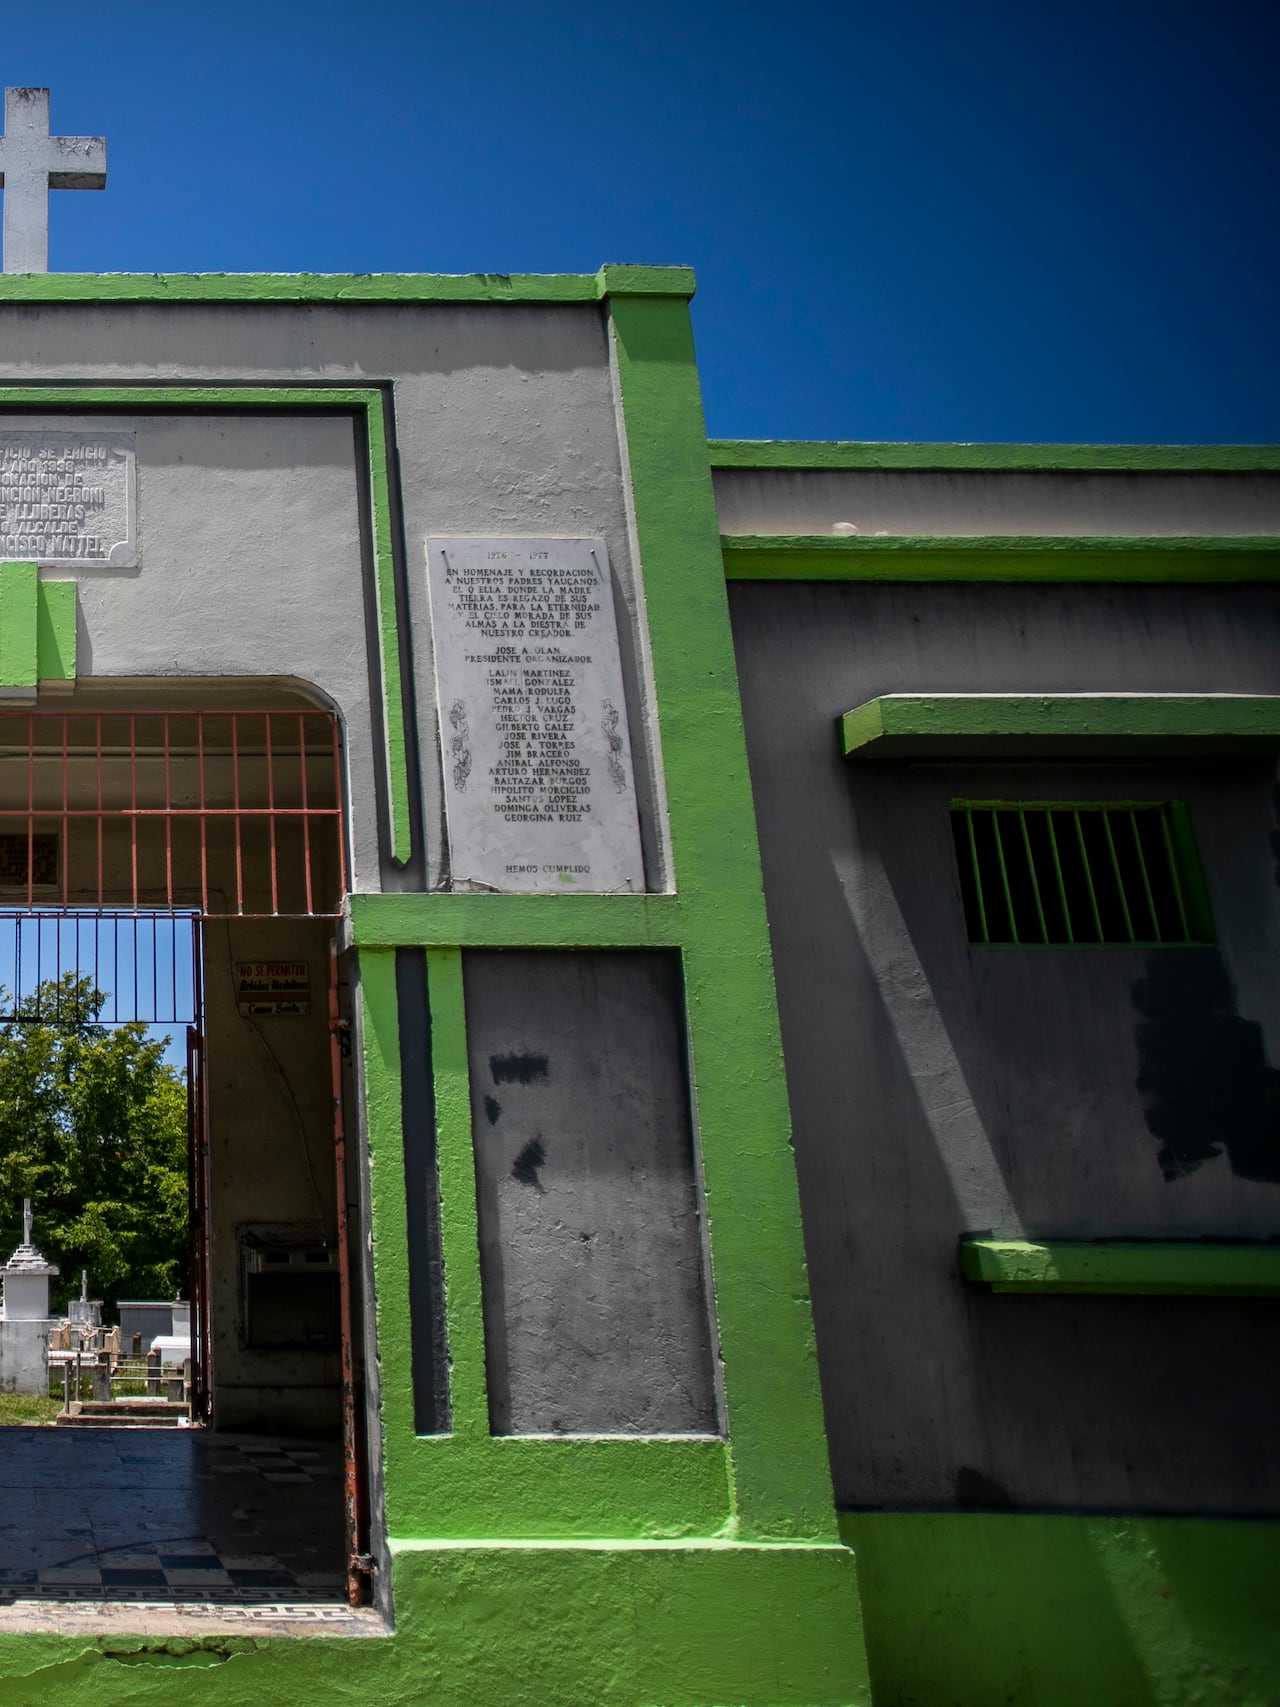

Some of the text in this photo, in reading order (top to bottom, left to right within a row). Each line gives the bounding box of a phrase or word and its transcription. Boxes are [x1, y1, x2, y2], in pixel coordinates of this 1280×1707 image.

[39, 448, 56, 458] SE
[11, 458, 37, 472] AÑO
[66, 474, 82, 485] DE
[48, 487, 105, 503] NEGRONI
[16, 504, 84, 520] LLUBERAS
[18, 521, 78, 533] ALCALDE
[447, 569, 458, 577] EN
[464, 569, 513, 577] HOMENAJE
[530, 569, 594, 577] RECORDACION
[457, 577, 504, 585] NUESTROS
[453, 586, 463, 594] EL
[508, 586, 537, 594] DONDE
[501, 603, 526, 611] PARA
[530, 603, 542, 611] LA
[515, 612, 554, 620] MORADA
[531, 621, 569, 629] DIESTRA
[575, 621, 585, 629] DE
[496, 647, 517, 655] JOSE
[524, 679, 575, 687] GONZALEZ
[501, 714, 568, 722] HECTOR CRUZ
[496, 723, 540, 731] GILBERTO
[504, 732, 567, 740] JOSE RIVERA
[499, 741, 521, 749] JOSE
[540, 741, 576, 749] TORRES
[506, 750, 569, 758] JIM BRACERO
[498, 759, 580, 767] ANIBAL ALFONSO
[494, 777, 587, 785] BALTAZAR BURGOS
[492, 786, 535, 794] HIPOLITO
[506, 795, 577, 803] SANTOS LOPEZ
[506, 865, 590, 873] HEMOS CUMPLIDO
